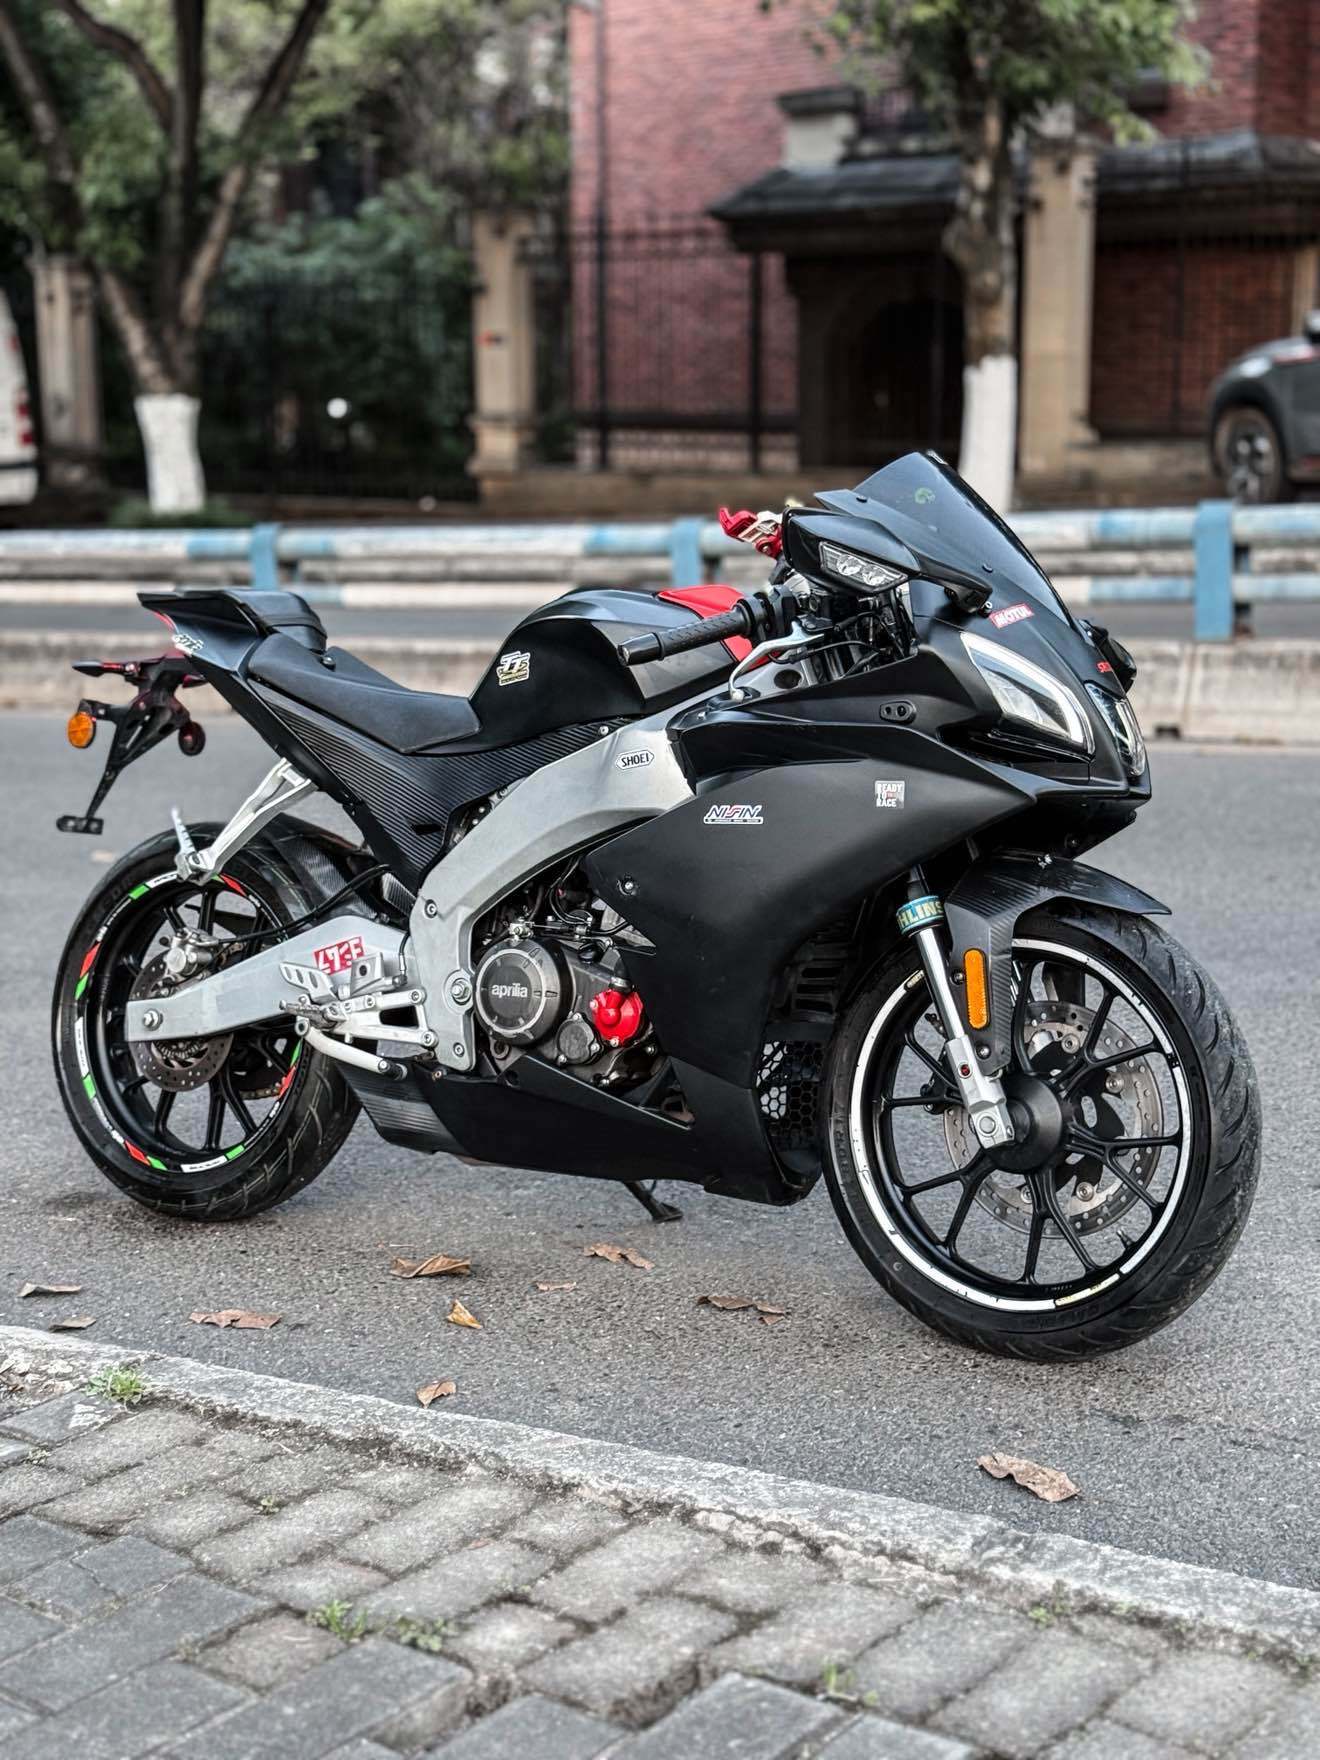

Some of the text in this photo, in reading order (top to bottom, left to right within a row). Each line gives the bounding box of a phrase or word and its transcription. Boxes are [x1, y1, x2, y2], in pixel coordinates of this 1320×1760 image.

[993, 605, 1032, 627] MOTUL
[621, 752, 650, 768] SHOEI
[876, 783, 903, 793] READY
[876, 799, 897, 808] RACE
[897, 901, 944, 928] HLINS
[491, 982, 528, 999] aprilia
